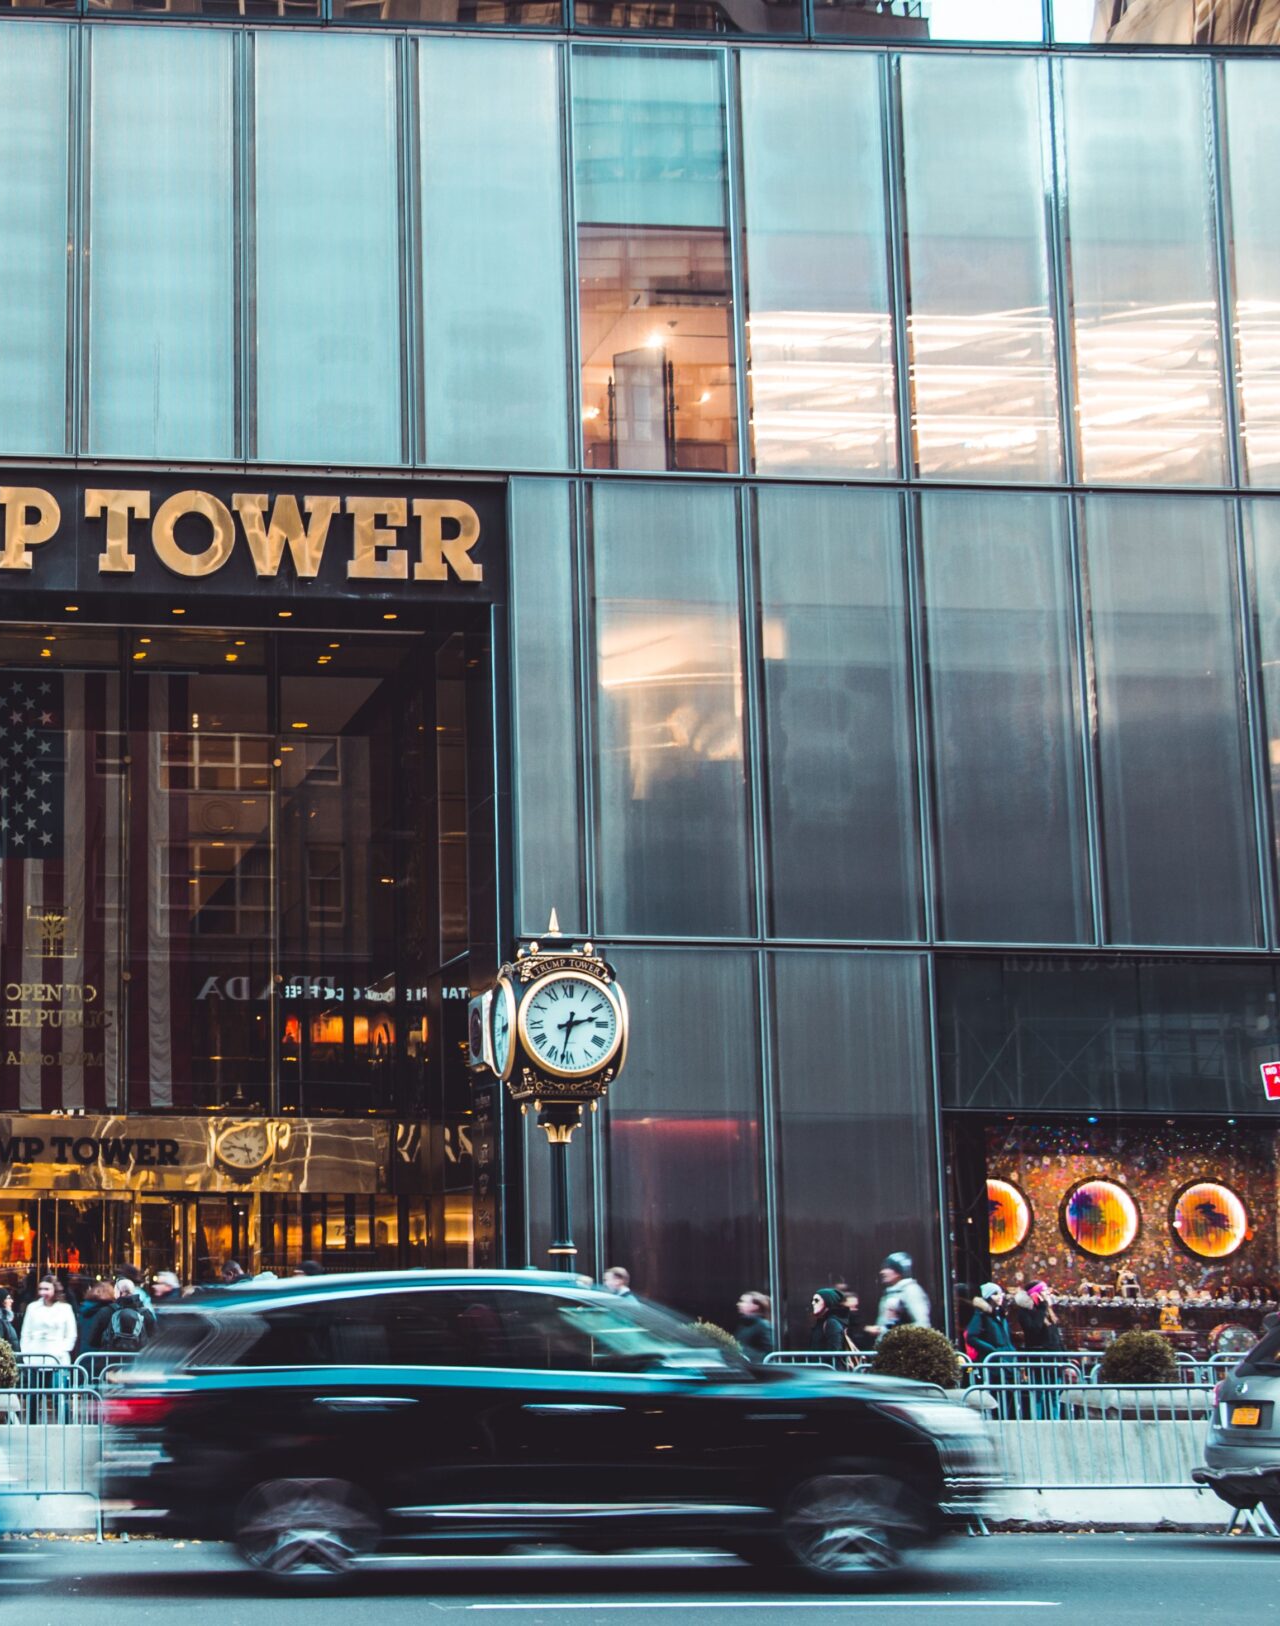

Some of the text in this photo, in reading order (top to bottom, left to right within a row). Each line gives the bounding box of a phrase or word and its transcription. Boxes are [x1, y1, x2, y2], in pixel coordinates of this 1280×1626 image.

[84, 488, 484, 582] TOWER
[534, 959, 601, 975] TRUMP TOWER
[5, 983, 63, 1002] OPEN
[50, 1136, 180, 1166] TOWER
